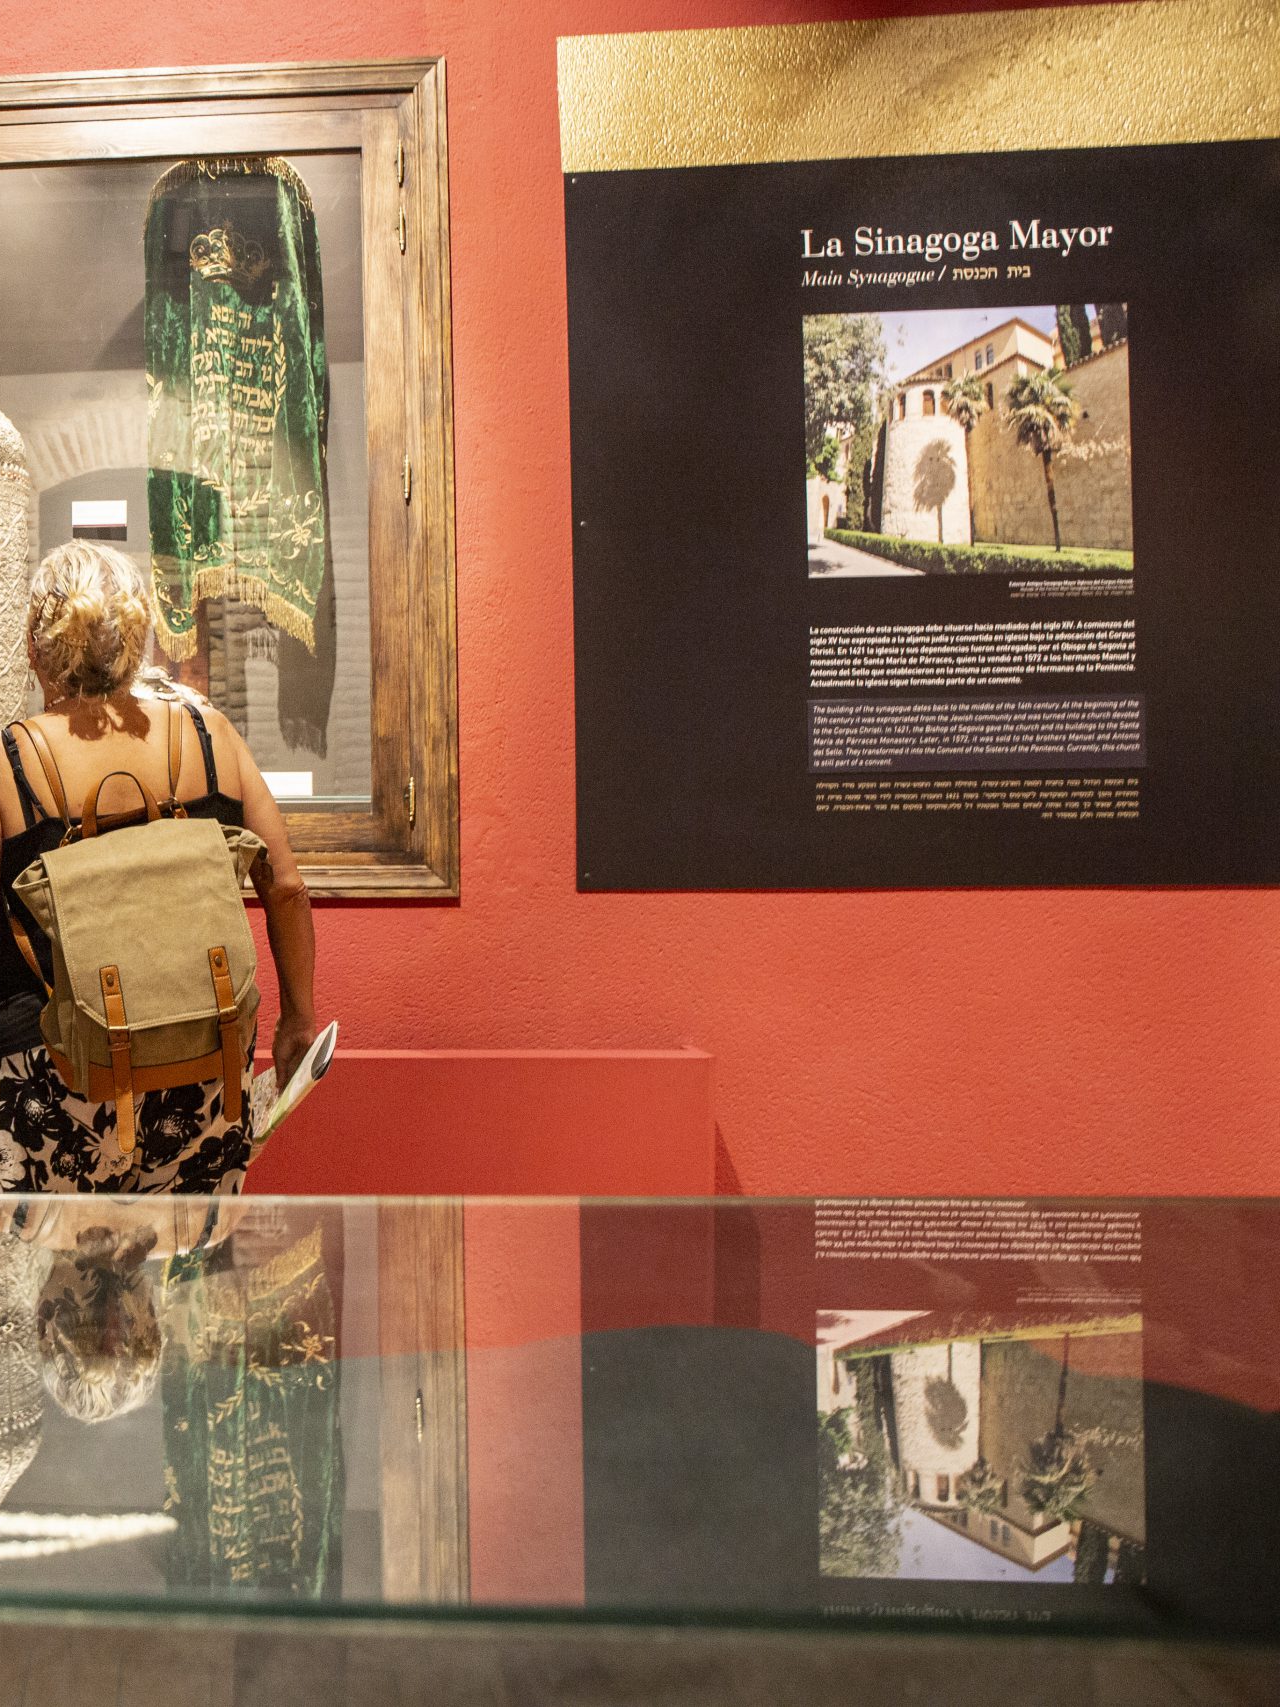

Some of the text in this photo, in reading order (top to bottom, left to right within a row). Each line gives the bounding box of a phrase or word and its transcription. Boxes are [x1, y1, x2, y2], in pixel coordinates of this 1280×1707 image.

[801, 219, 1112, 263] La Sinagoga Mayor
[801, 270, 843, 287] Main
[847, 268, 935, 288] Synagogue
[1007, 265, 1031, 279] בית
